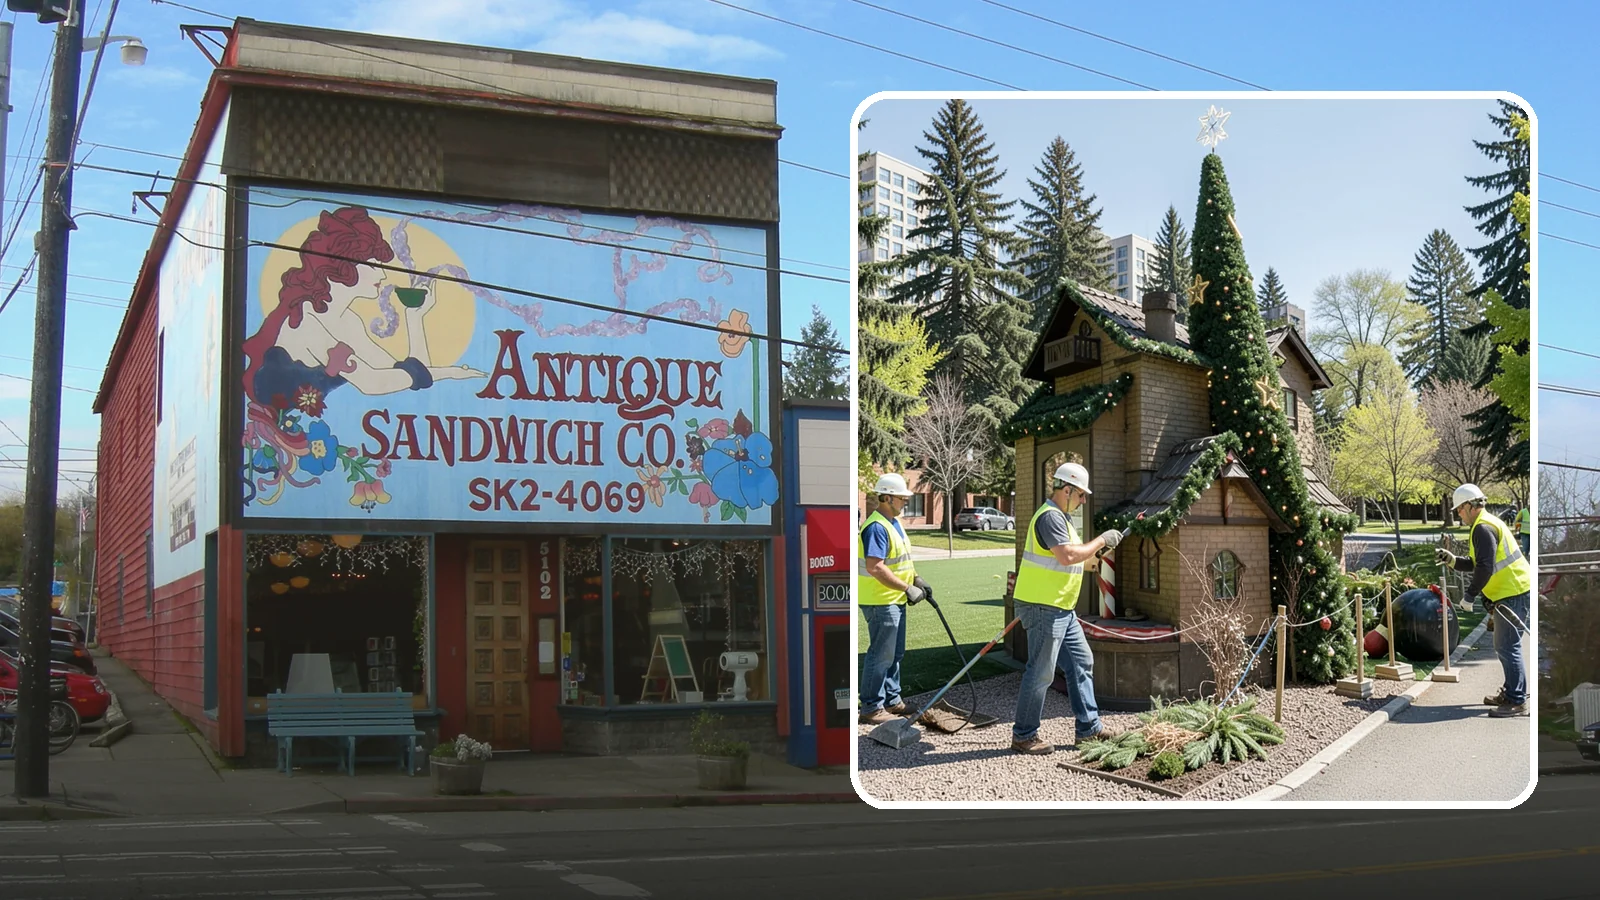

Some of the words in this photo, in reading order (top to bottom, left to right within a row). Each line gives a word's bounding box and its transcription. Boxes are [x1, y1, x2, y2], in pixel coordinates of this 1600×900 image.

[476, 329, 723, 421] ANTIQUE
[360, 409, 604, 467] SANDWICH
[616, 421, 685, 469] CO.
[468, 477, 645, 512] SK2-4069
[540, 541, 551, 600] 5102
[809, 555, 834, 568] BOOKS
